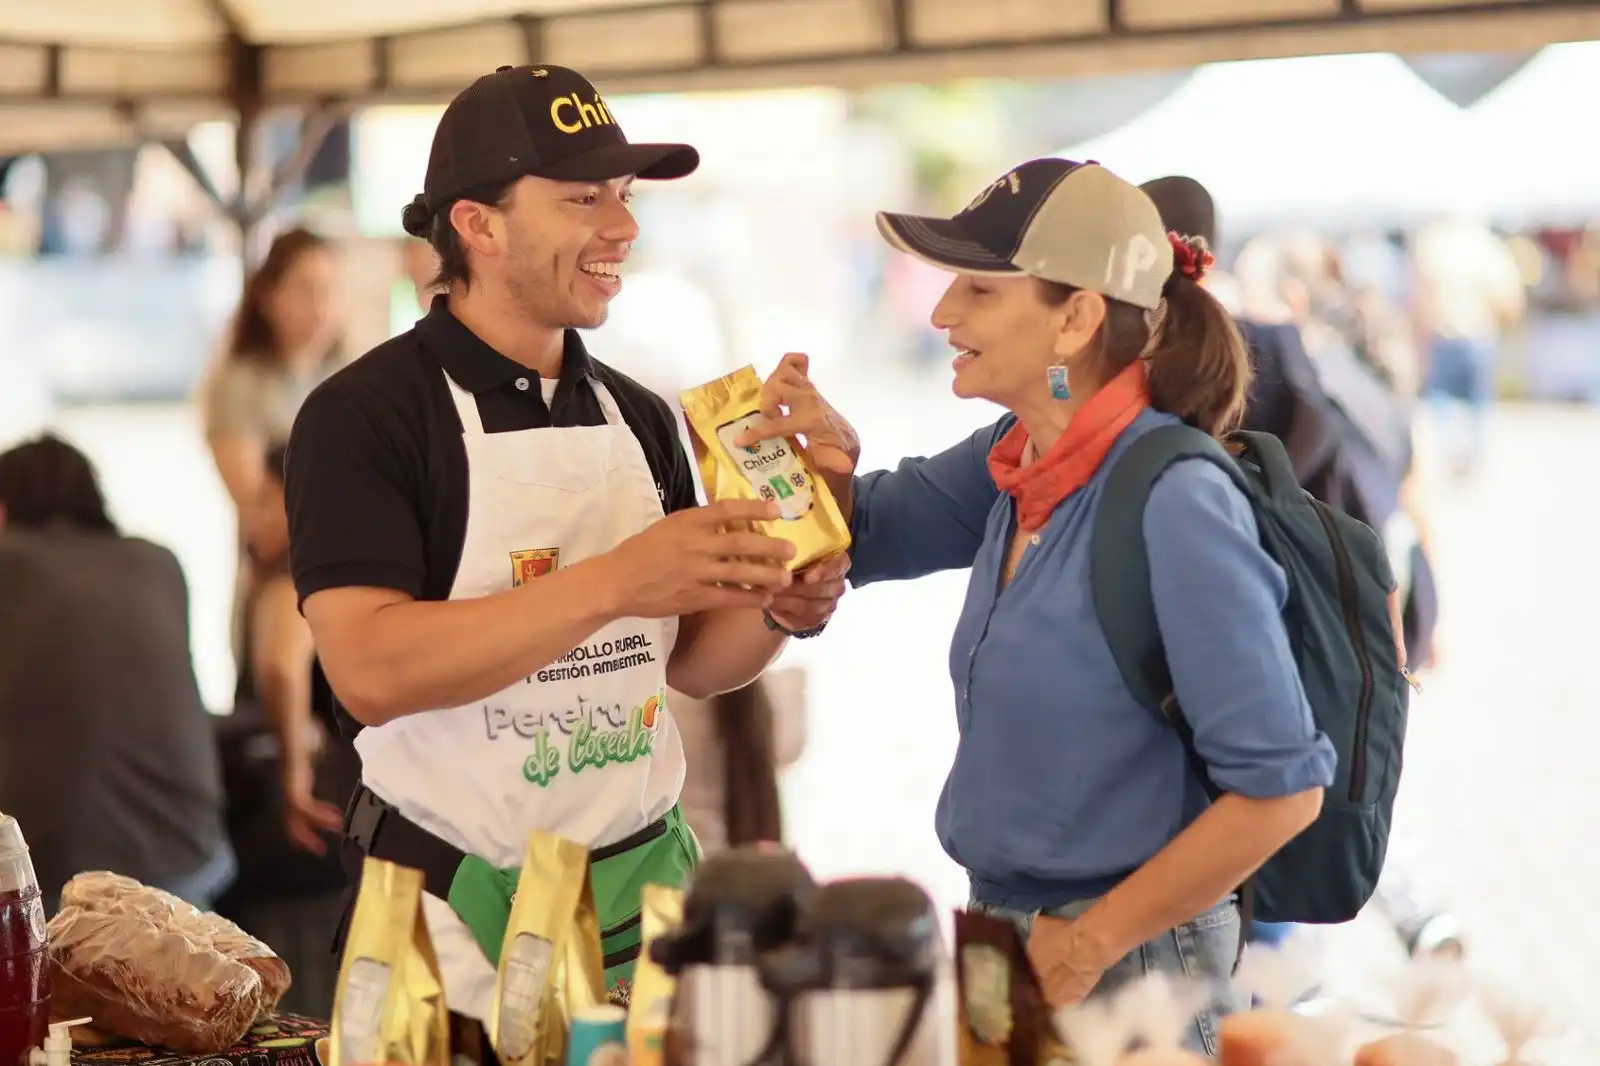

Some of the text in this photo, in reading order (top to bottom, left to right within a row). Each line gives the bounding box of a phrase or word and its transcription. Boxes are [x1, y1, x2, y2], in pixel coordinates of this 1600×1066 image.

[615, 633, 652, 653] RURAL
[537, 663, 590, 683] GESTIÓN
[523, 730, 560, 787] de
